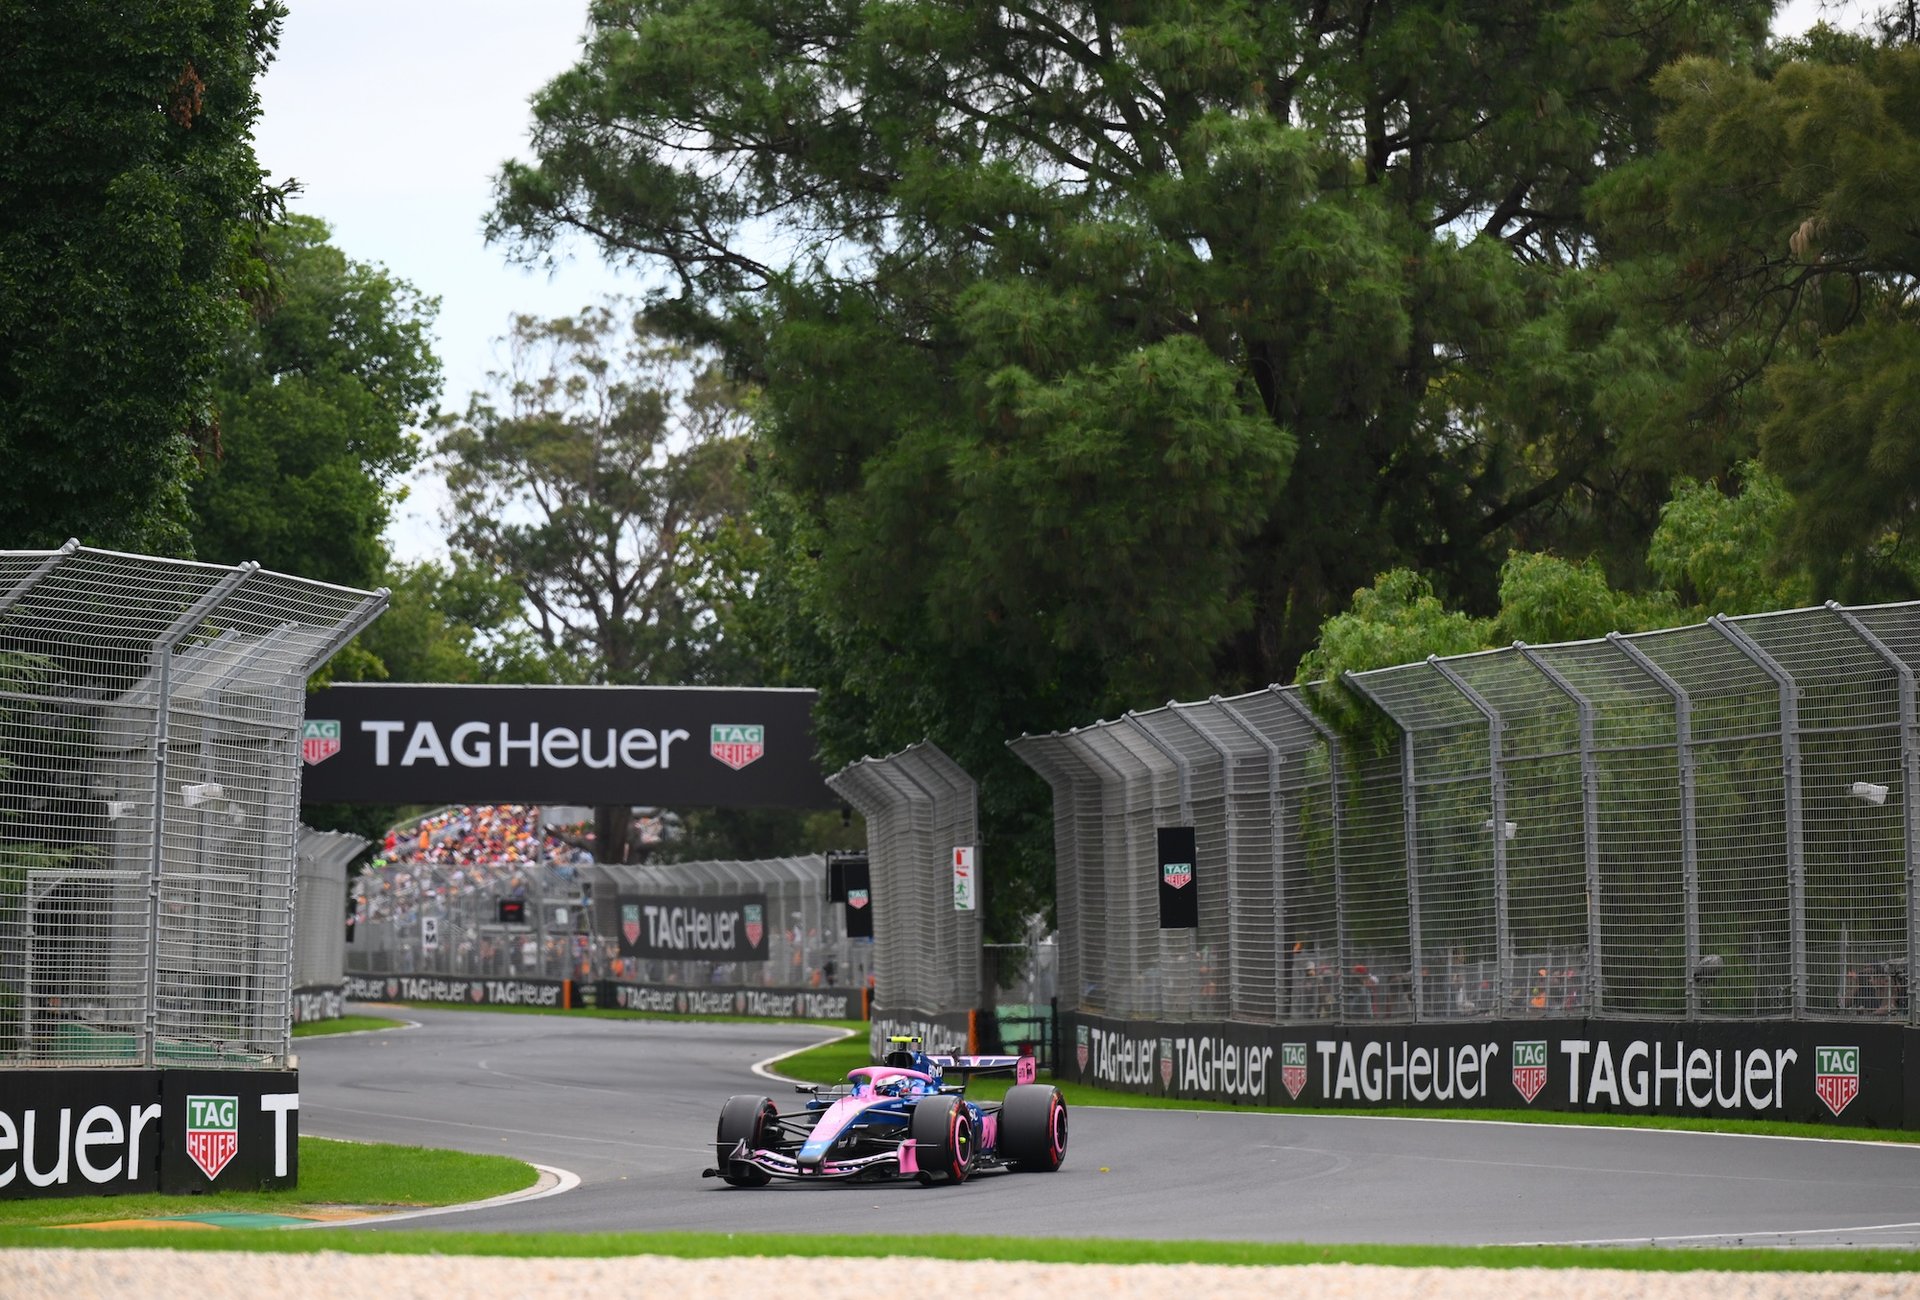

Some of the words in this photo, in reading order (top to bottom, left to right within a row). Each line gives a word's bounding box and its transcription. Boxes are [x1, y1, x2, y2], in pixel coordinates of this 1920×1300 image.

[304, 723, 336, 737] AG
[716, 728, 760, 742] TAG
[303, 740, 338, 760] EUER
[713, 744, 762, 766] HEUER
[1166, 865, 1188, 873] TAG
[1284, 1047, 1305, 1064] TAG
[1515, 1045, 1545, 1064] TAG
[1819, 1051, 1857, 1072] TAG
[1514, 1068, 1546, 1097] HEUER
[1818, 1077, 1858, 1111] HEUER
[191, 1102, 234, 1127] TAG
[189, 1133, 235, 1173] HEUER
